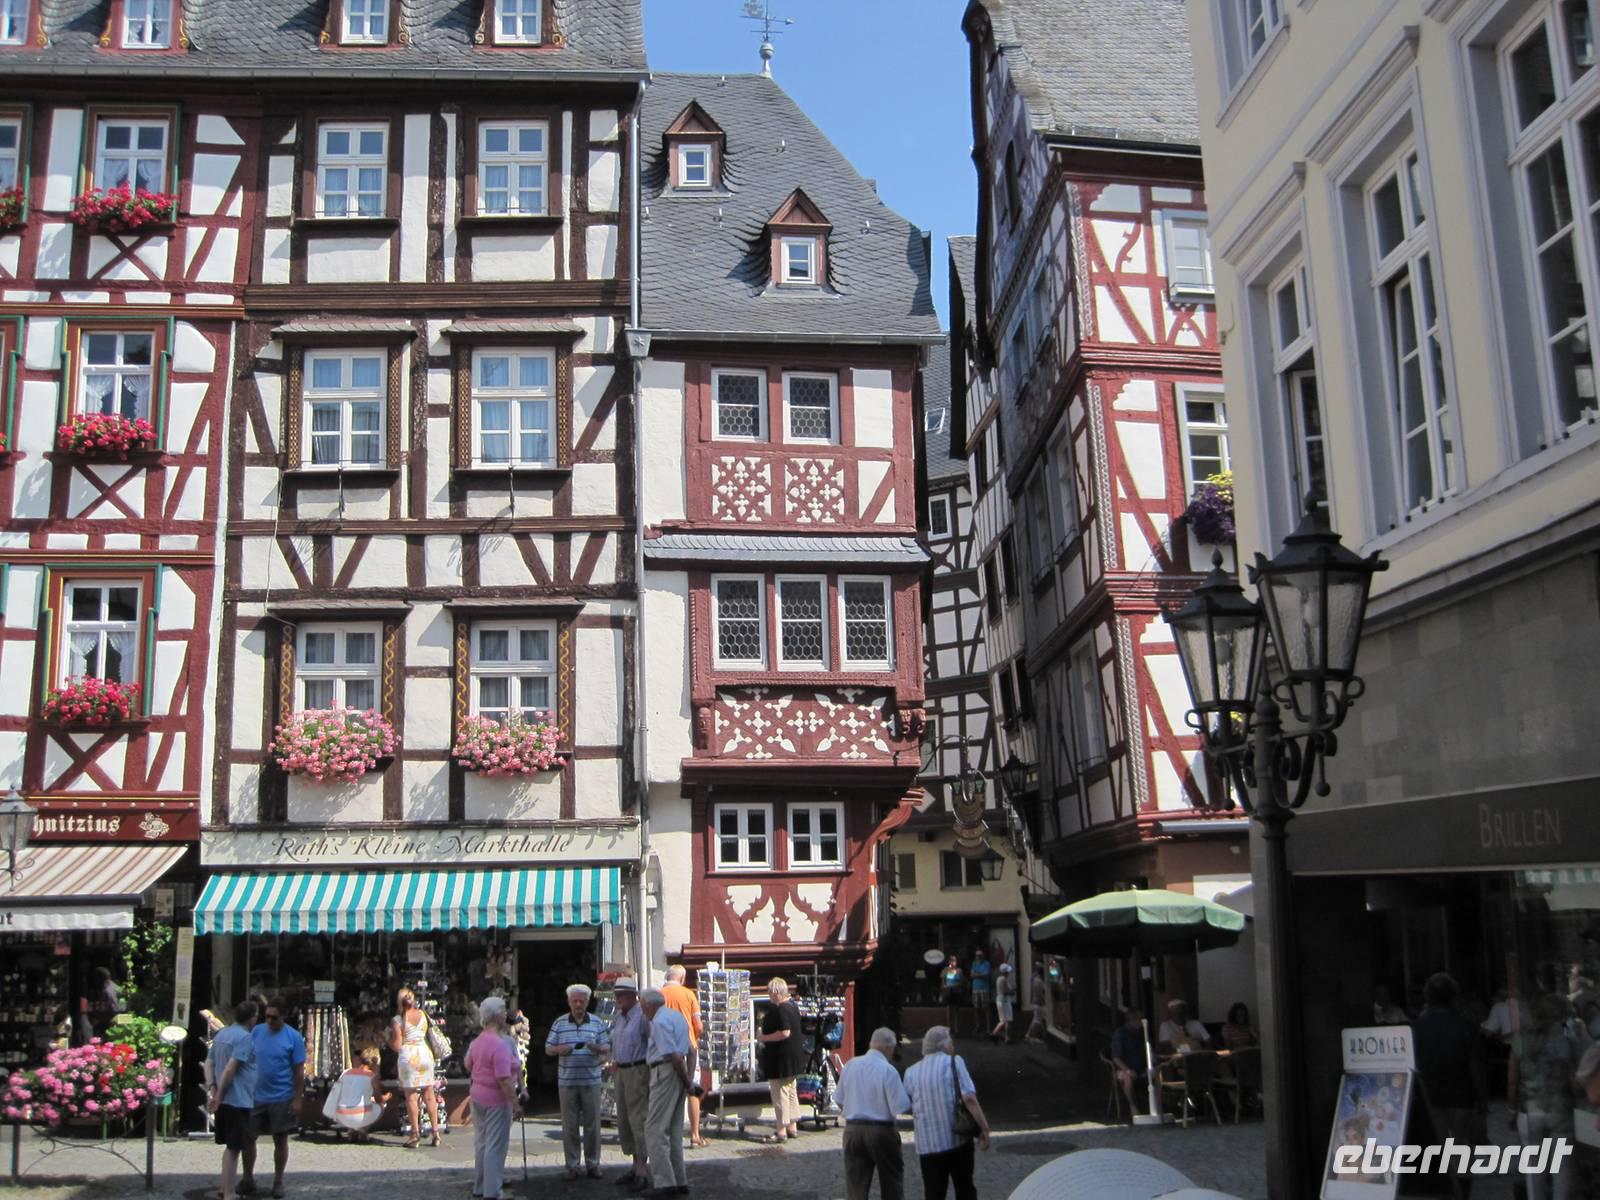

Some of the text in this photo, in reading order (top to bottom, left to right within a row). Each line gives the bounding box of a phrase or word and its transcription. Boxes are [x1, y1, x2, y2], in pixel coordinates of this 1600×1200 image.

[32, 814, 121, 838] hnitzius
[1479, 802, 1562, 848] BRILLEN
[353, 836, 427, 859] Kleine
[434, 835, 570, 855] Markthalle
